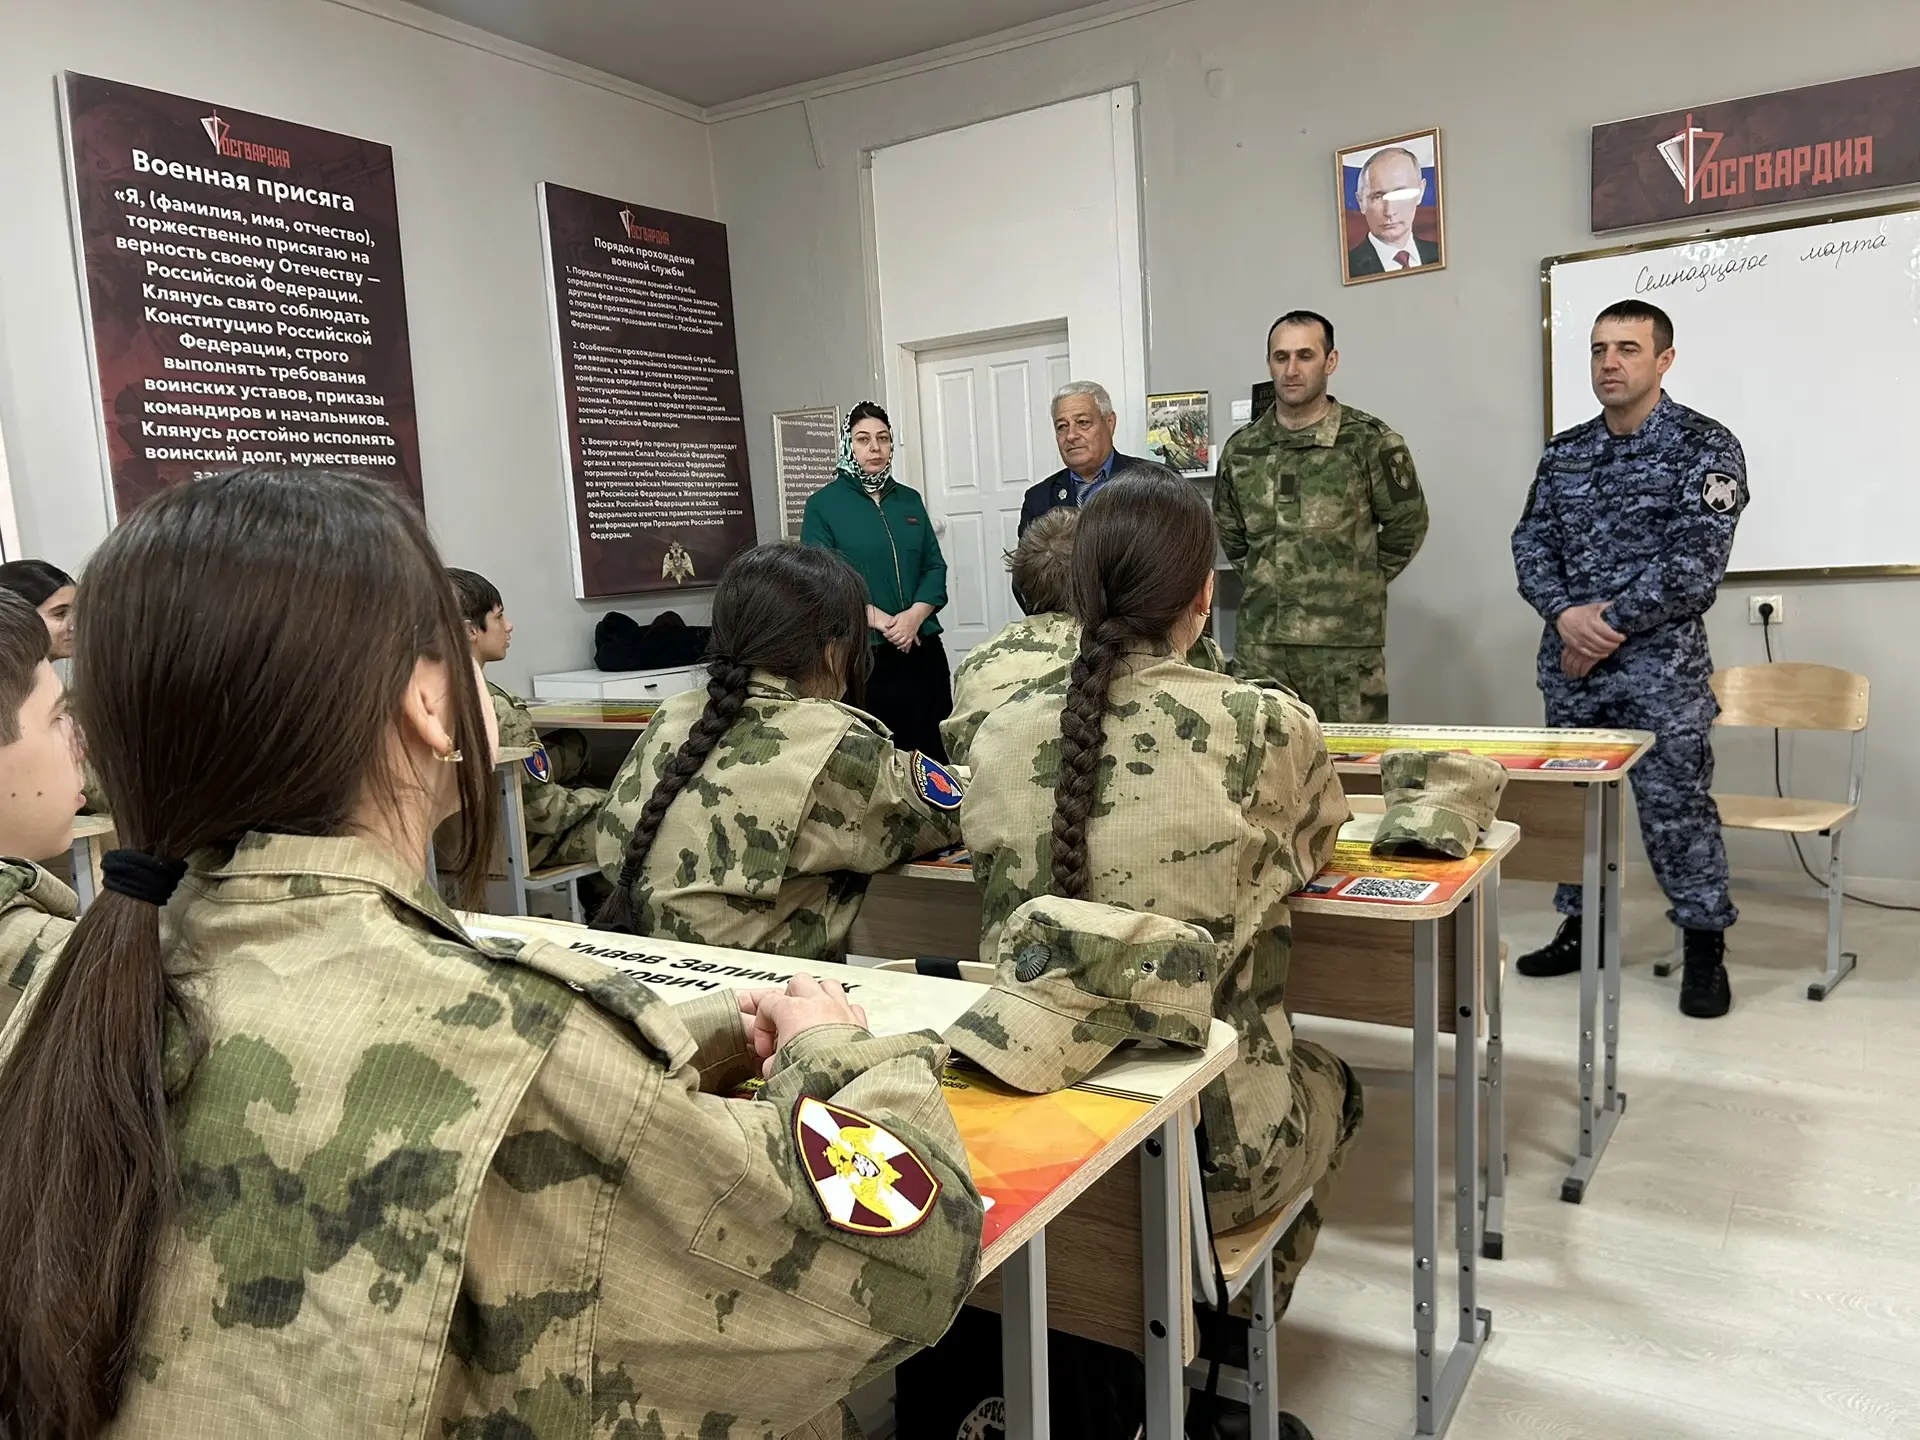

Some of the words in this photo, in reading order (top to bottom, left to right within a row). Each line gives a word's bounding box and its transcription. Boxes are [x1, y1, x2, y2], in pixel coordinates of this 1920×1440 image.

[131, 148, 251, 193] Военная
[256, 178, 355, 213] присяга
[113, 187, 146, 209] «Я,
[149, 189, 248, 226] (фамилия,
[250, 212, 291, 234] имя,
[292, 220, 376, 248] отчество),
[125, 214, 263, 248] торжественно
[265, 237, 348, 261] присягаю
[350, 251, 371, 265] на
[593, 236, 636, 255] Порядок
[635, 247, 696, 266] прохождения
[1800, 233, 1887, 268] марта
[115, 236, 208, 261] верность
[210, 250, 276, 275] своему
[278, 257, 364, 288] Отечеству
[610, 256, 651, 272] военной
[650, 263, 685, 278] службы
[145, 259, 258, 290] Российской
[260, 275, 364, 305] Федерации.
[141, 282, 224, 309] Клянусь
[226, 296, 277, 314] свято
[279, 302, 371, 325] соблюдать
[143, 305, 274, 335] Конституцию
[276, 320, 373, 346] Российской
[178, 331, 293, 361] Федерации,
[294, 347, 350, 364] строго
[163, 356, 267, 377] выполнять
[268, 365, 367, 386] требования
[143, 378, 237, 397] воинских
[239, 384, 313, 405] уставов,
[315, 390, 385, 407] приказы
[143, 400, 263, 422] командиров
[265, 408, 278, 421] и
[280, 409, 390, 427] начальников.
[140, 420, 223, 443] Клянусь
[225, 425, 311, 444] достойно
[312, 431, 396, 447] исполнять
[144, 445, 239, 462] воинский
[241, 450, 288, 466] долг,
[289, 451, 397, 468] мужественно
